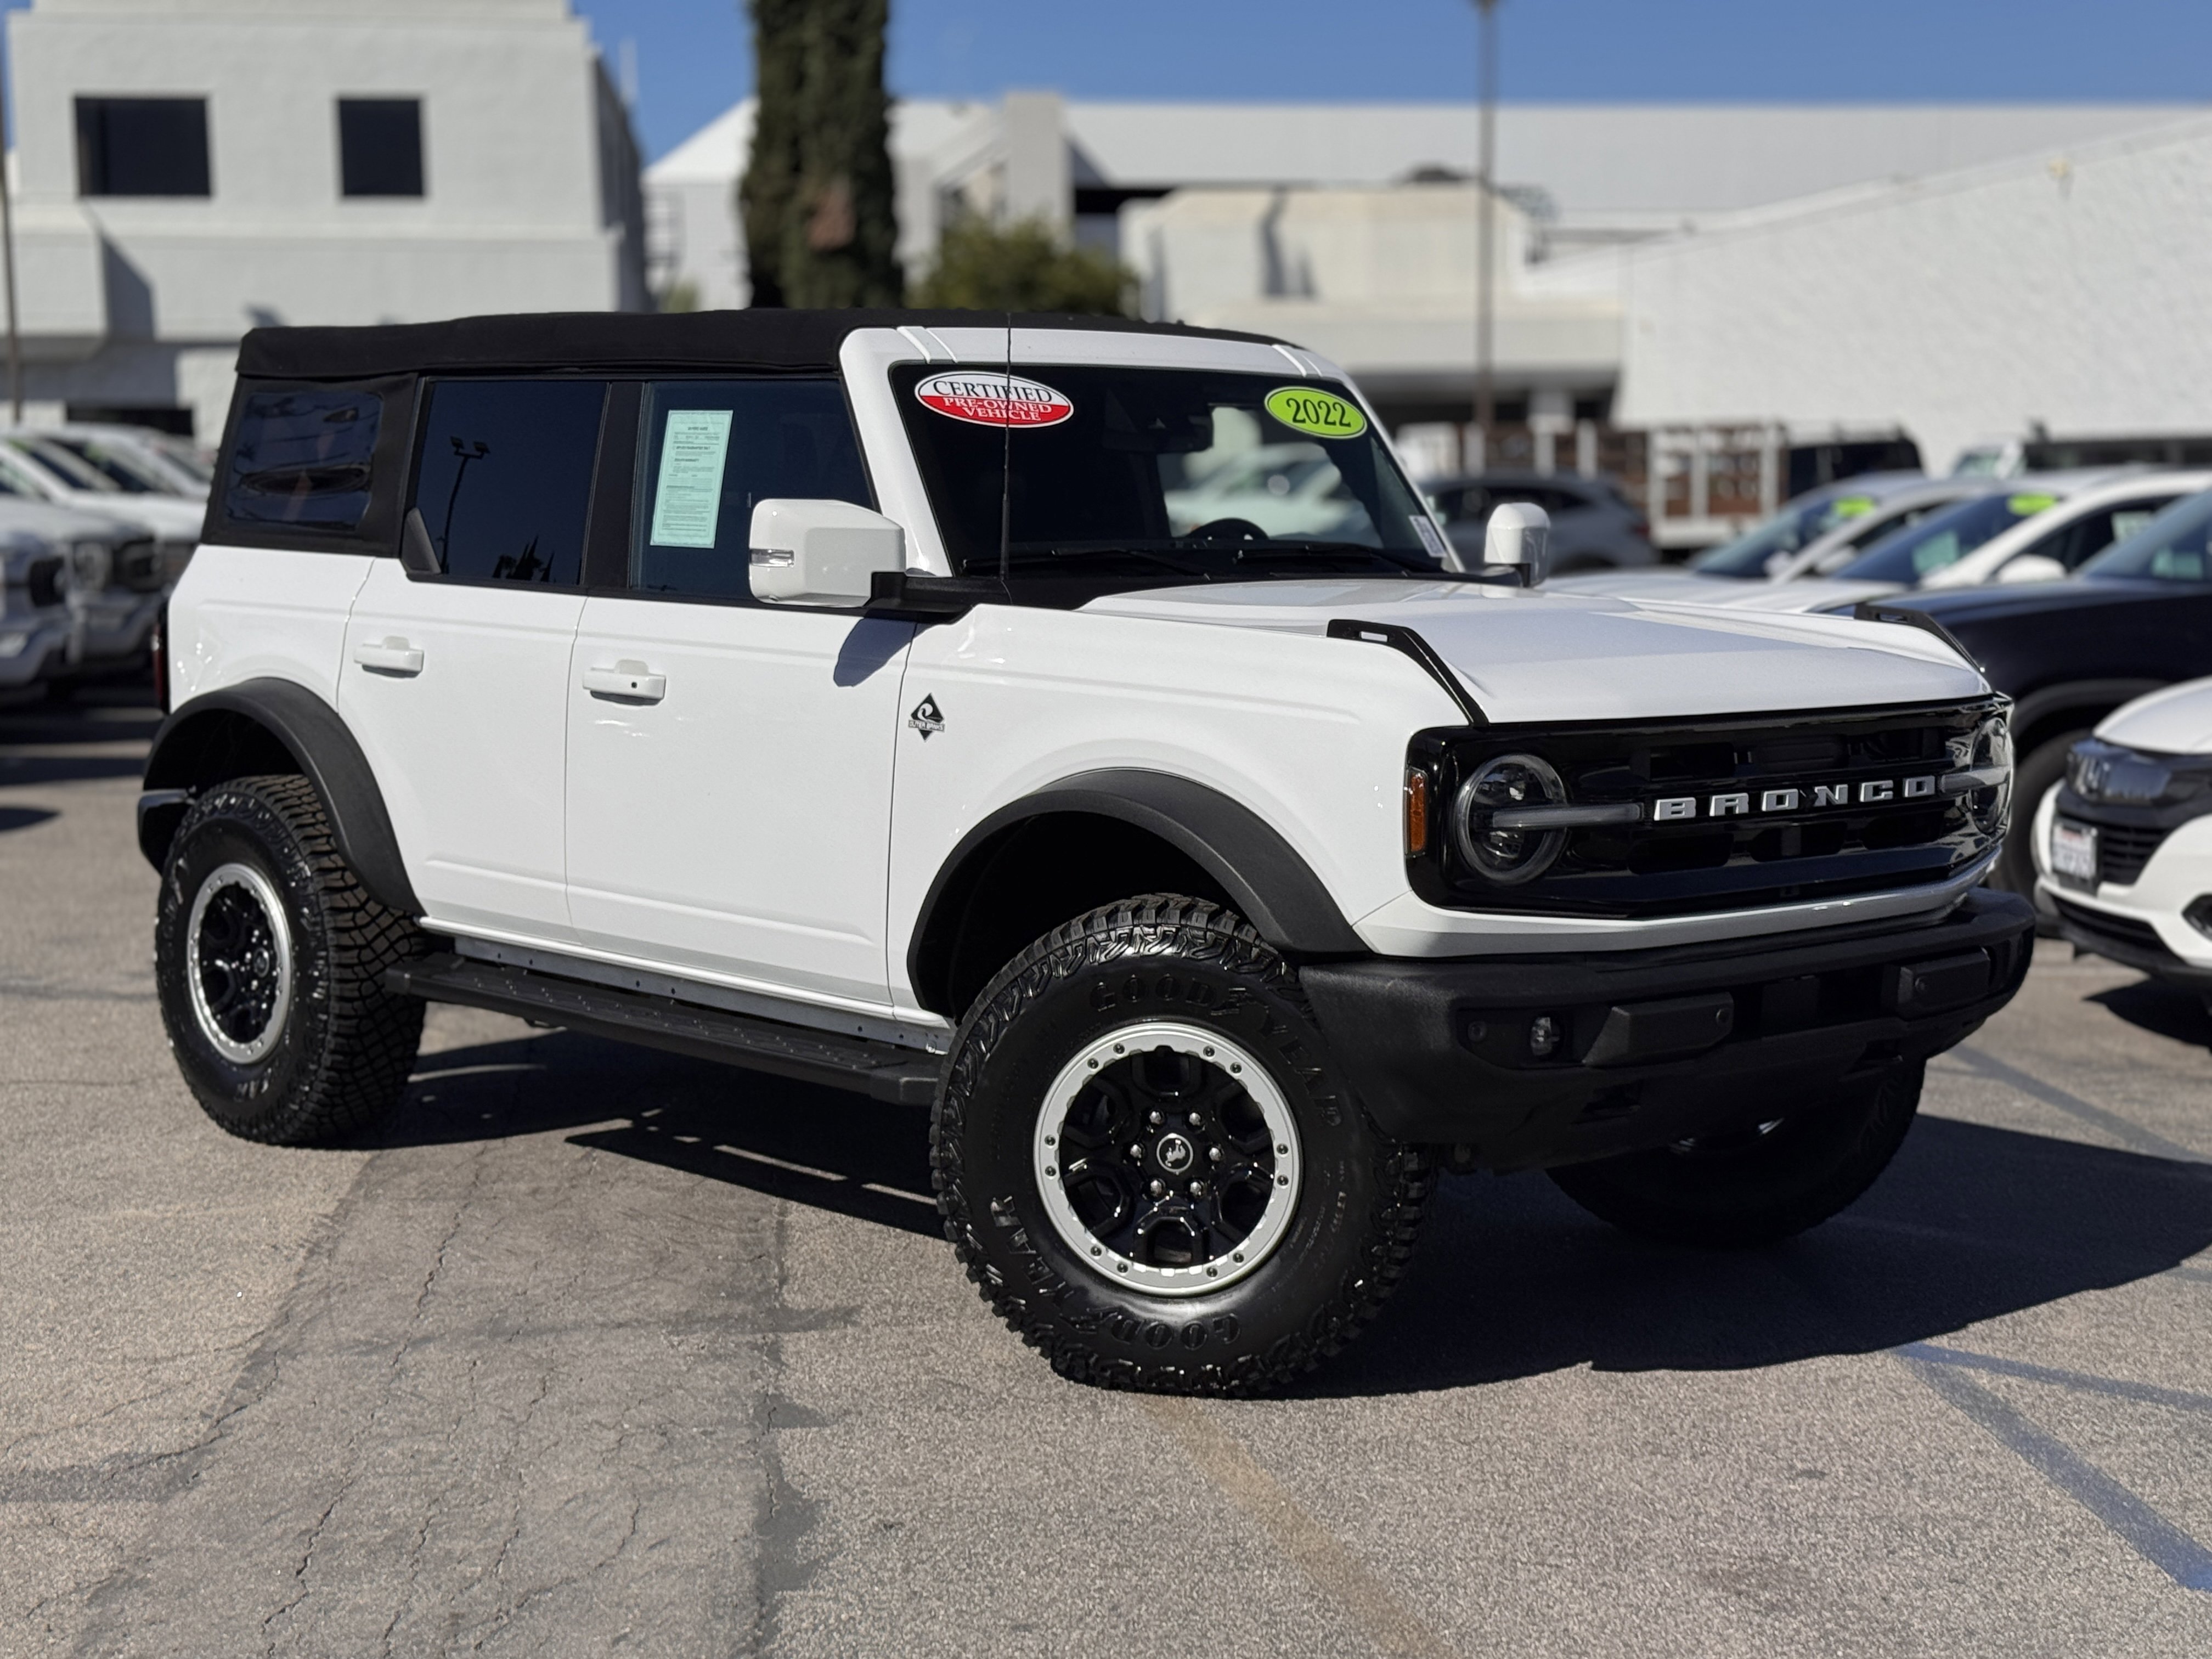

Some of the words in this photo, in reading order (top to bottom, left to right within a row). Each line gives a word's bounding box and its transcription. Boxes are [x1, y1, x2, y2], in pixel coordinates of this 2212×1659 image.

[934, 381, 1052, 402] CERTIFIED
[943, 397, 1052, 413] PRE-OWNED
[962, 407, 1041, 421] VEHICLE
[1286, 398, 1351, 427] 2022
[1654, 776, 1936, 821] BRONCO
